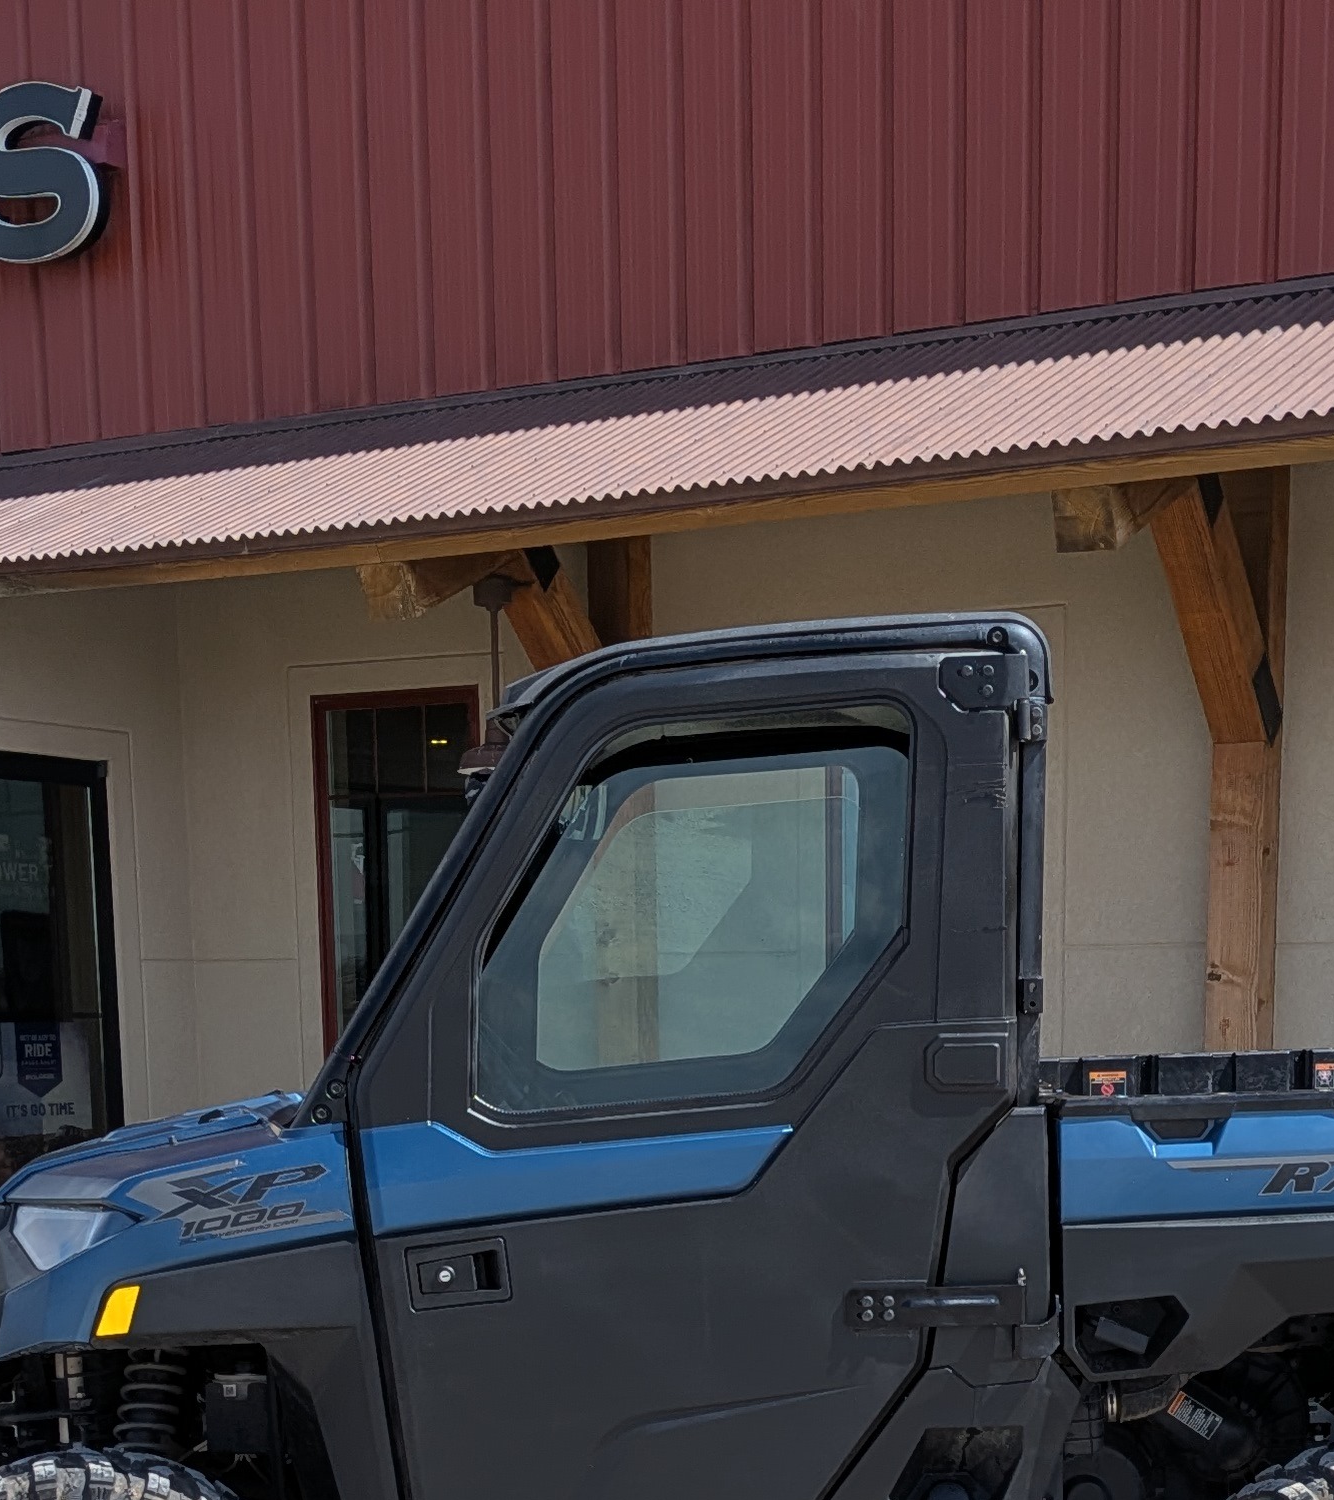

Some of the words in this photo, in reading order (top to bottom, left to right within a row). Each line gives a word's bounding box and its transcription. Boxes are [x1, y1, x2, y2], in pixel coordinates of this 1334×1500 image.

[24, 1043, 53, 1058] RIDE
[6, 1104, 27, 1118] IT'S
[30, 1103, 46, 1117] GO
[48, 1102, 75, 1116] TIME
[158, 1164, 328, 1220] XP
[181, 1201, 306, 1238] 1000
